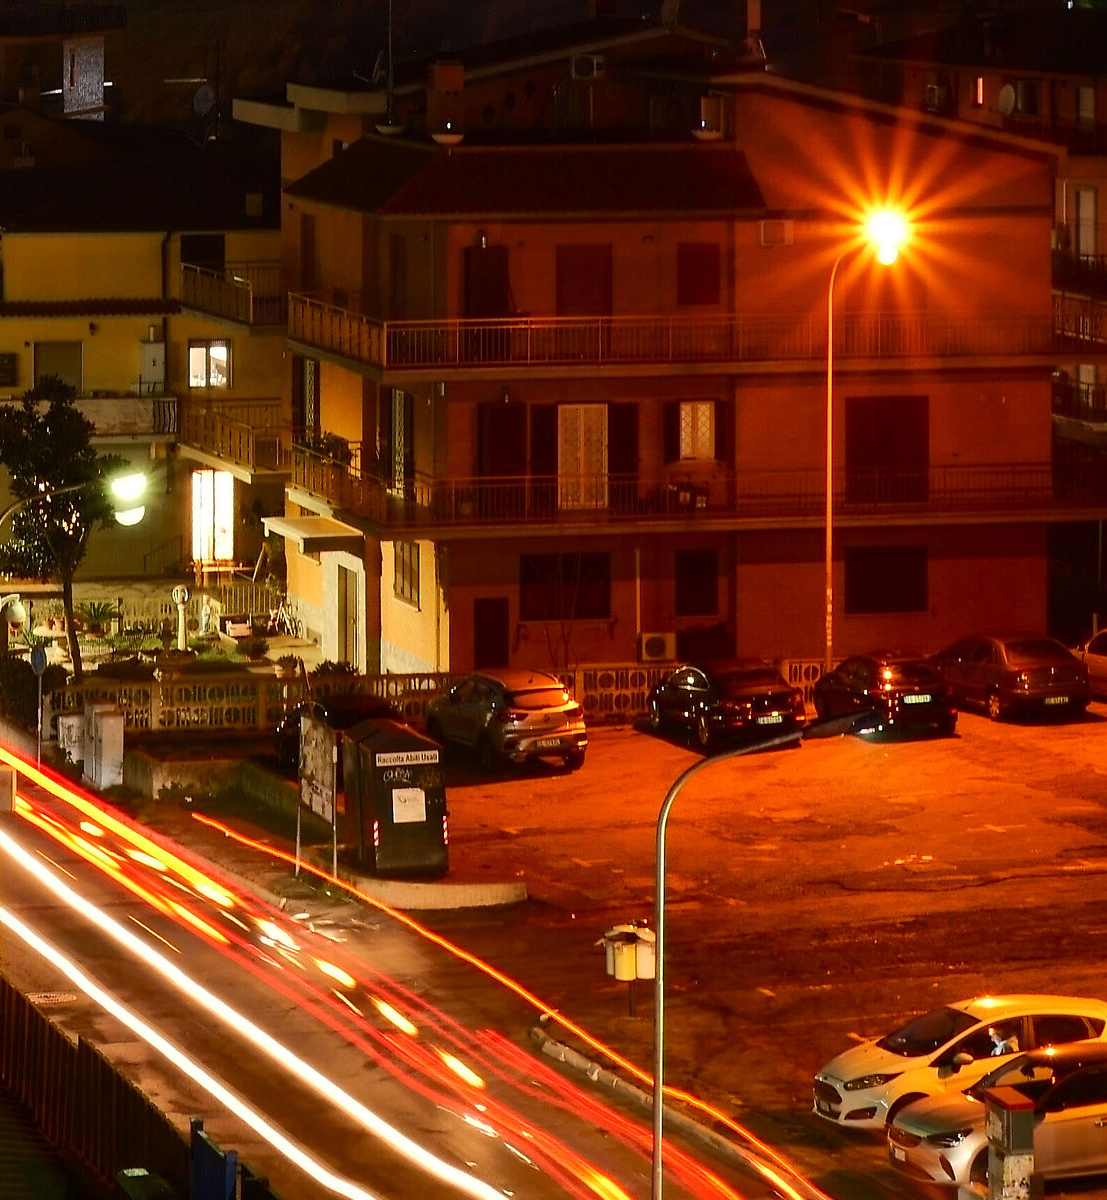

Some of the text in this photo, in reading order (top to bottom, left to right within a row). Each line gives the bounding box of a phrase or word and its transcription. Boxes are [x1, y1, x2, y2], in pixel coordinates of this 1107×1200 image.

[377, 752, 437, 764] Raccolta Abiti Usati
